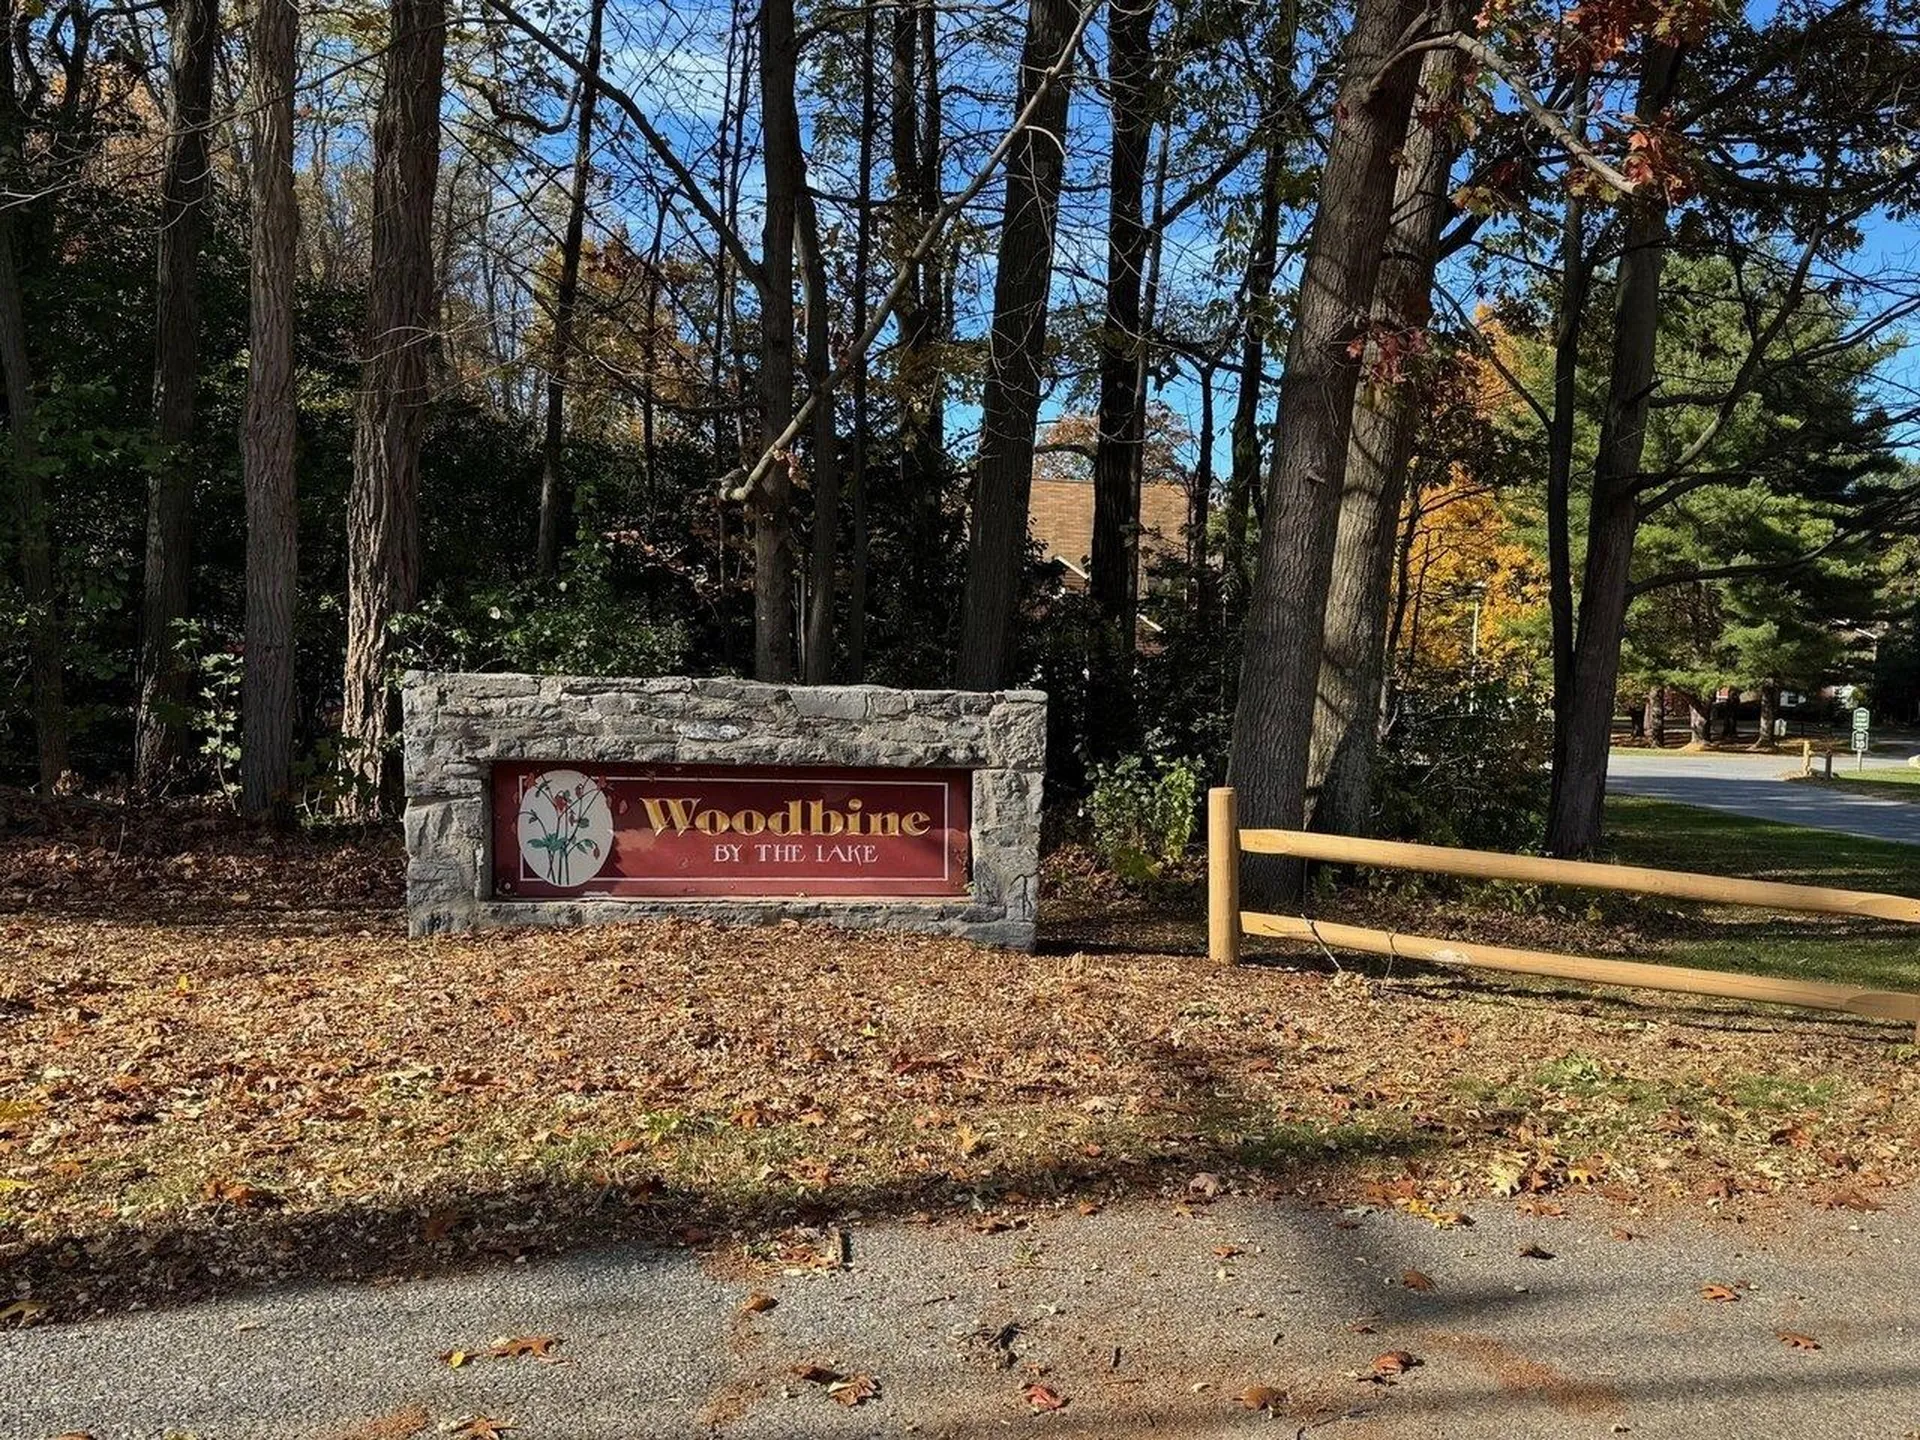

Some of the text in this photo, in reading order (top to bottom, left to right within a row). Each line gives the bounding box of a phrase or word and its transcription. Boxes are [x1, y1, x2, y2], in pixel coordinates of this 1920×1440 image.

[640, 797, 930, 836] Woodbine
[713, 843, 879, 866] BY THE LAKE
